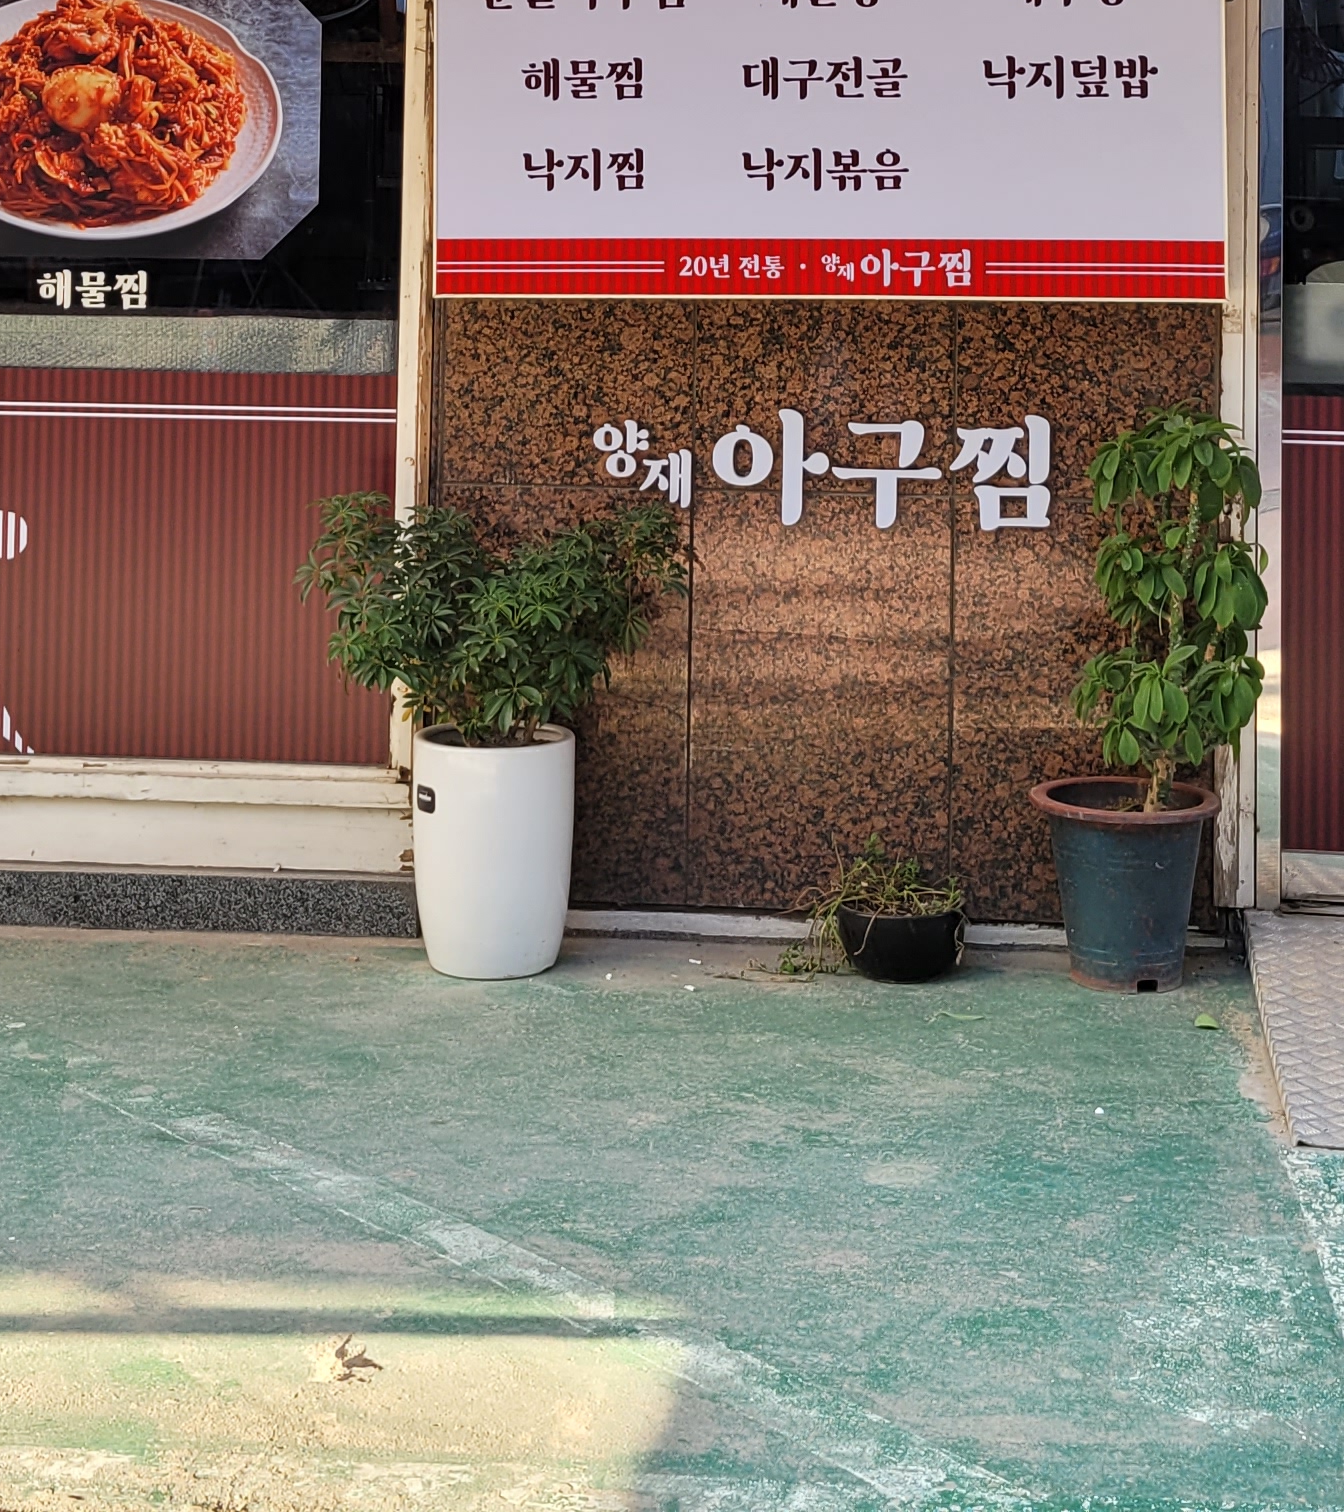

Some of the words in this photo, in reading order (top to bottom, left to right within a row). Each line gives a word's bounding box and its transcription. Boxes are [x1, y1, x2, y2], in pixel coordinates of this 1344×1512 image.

[521, 57, 643, 102] 해물찜
[742, 55, 909, 100] 대구전골
[982, 54, 1159, 100] 낙지덮밥
[522, 147, 644, 192] 낙지찜
[741, 147, 910, 192] 낙지볶음
[36, 268, 148, 311] 해물찜
[678, 253, 731, 279] 20년
[738, 253, 785, 279] 전통
[820, 252, 855, 283] 양재
[860, 248, 972, 288] 아구찜
[592, 419, 692, 509] 양재
[712, 408, 1051, 532] 아구찜
